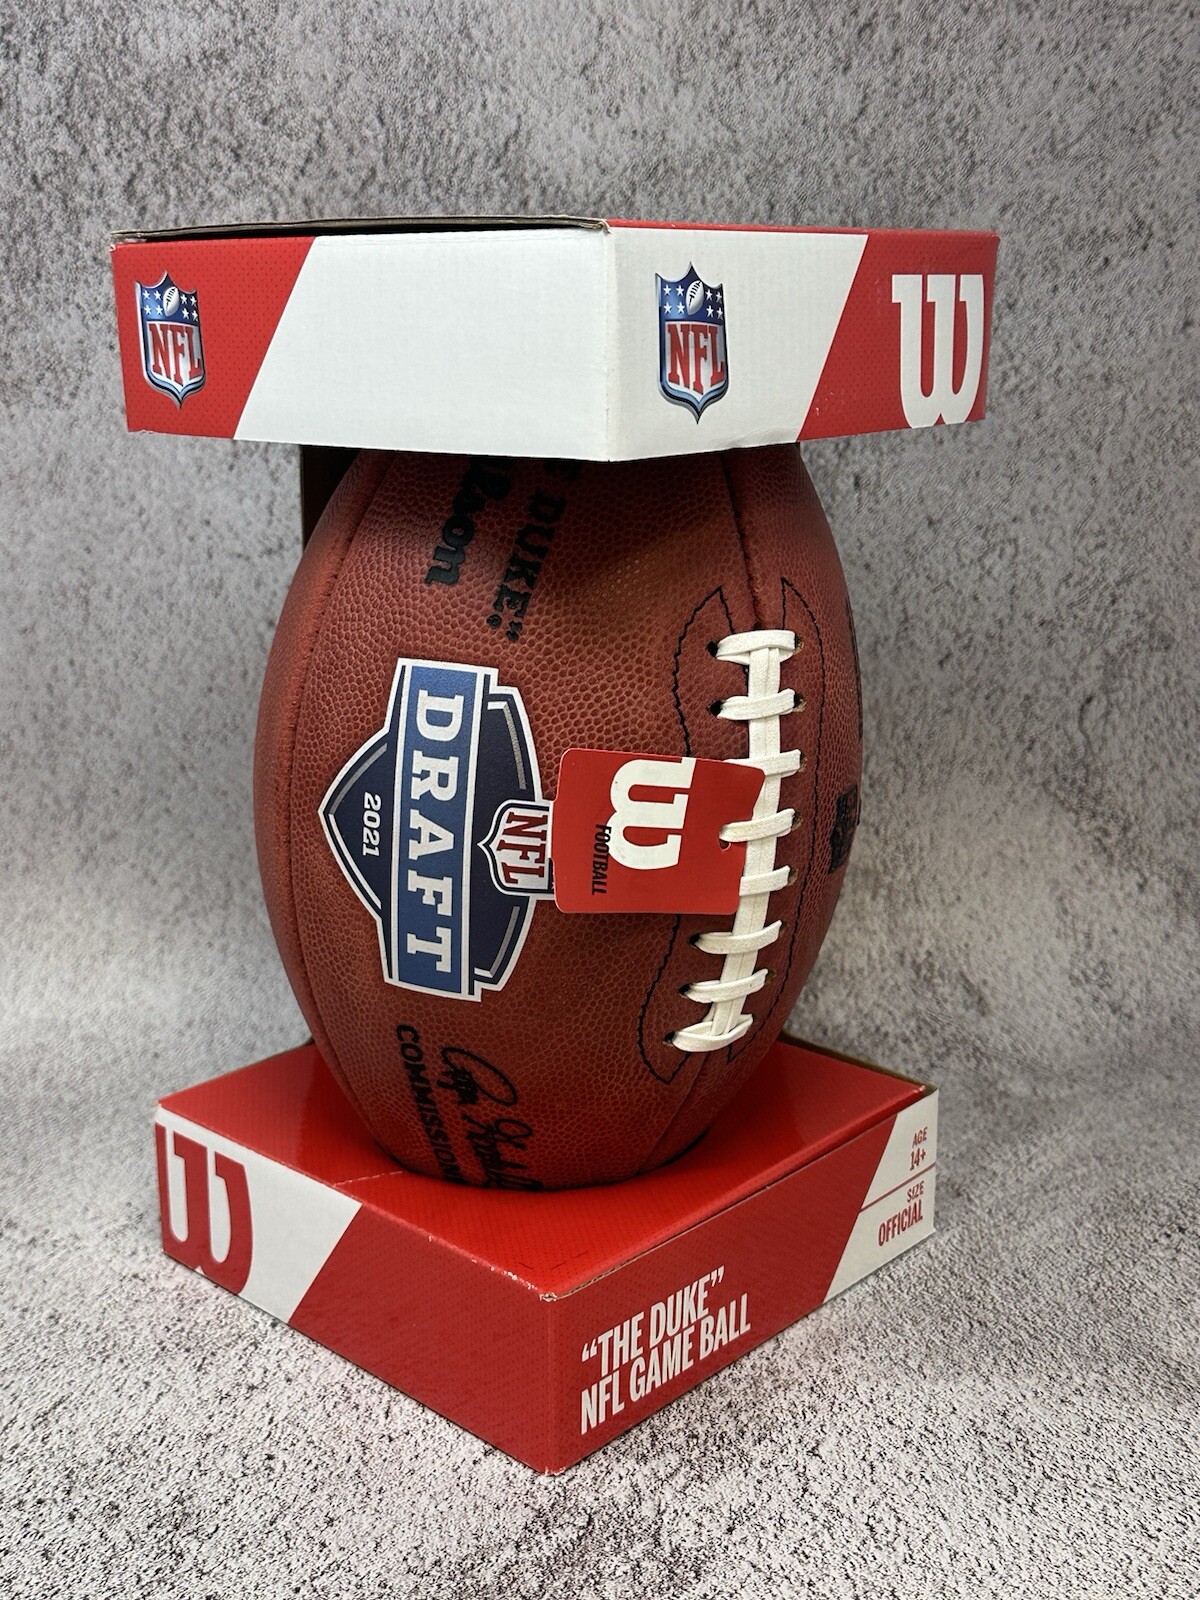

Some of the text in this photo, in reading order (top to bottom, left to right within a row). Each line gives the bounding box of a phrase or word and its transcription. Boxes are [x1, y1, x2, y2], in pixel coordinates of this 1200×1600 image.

[148, 323, 203, 388] NFL
[666, 323, 726, 395] NFL
[362, 791, 382, 857] 2021
[406, 689, 464, 973] DRAFT
[496, 811, 548, 889] NFL
[591, 823, 612, 895] FOOTBALL
[910, 1147, 926, 1171] 14+
[912, 1126, 928, 1147] AGE
[878, 1199, 923, 1246] OFFICIAL
[907, 1180, 925, 1202] SIZE
[581, 1265, 725, 1377] "THE DUKE"
[580, 1293, 751, 1435] NFL GAME BALL
